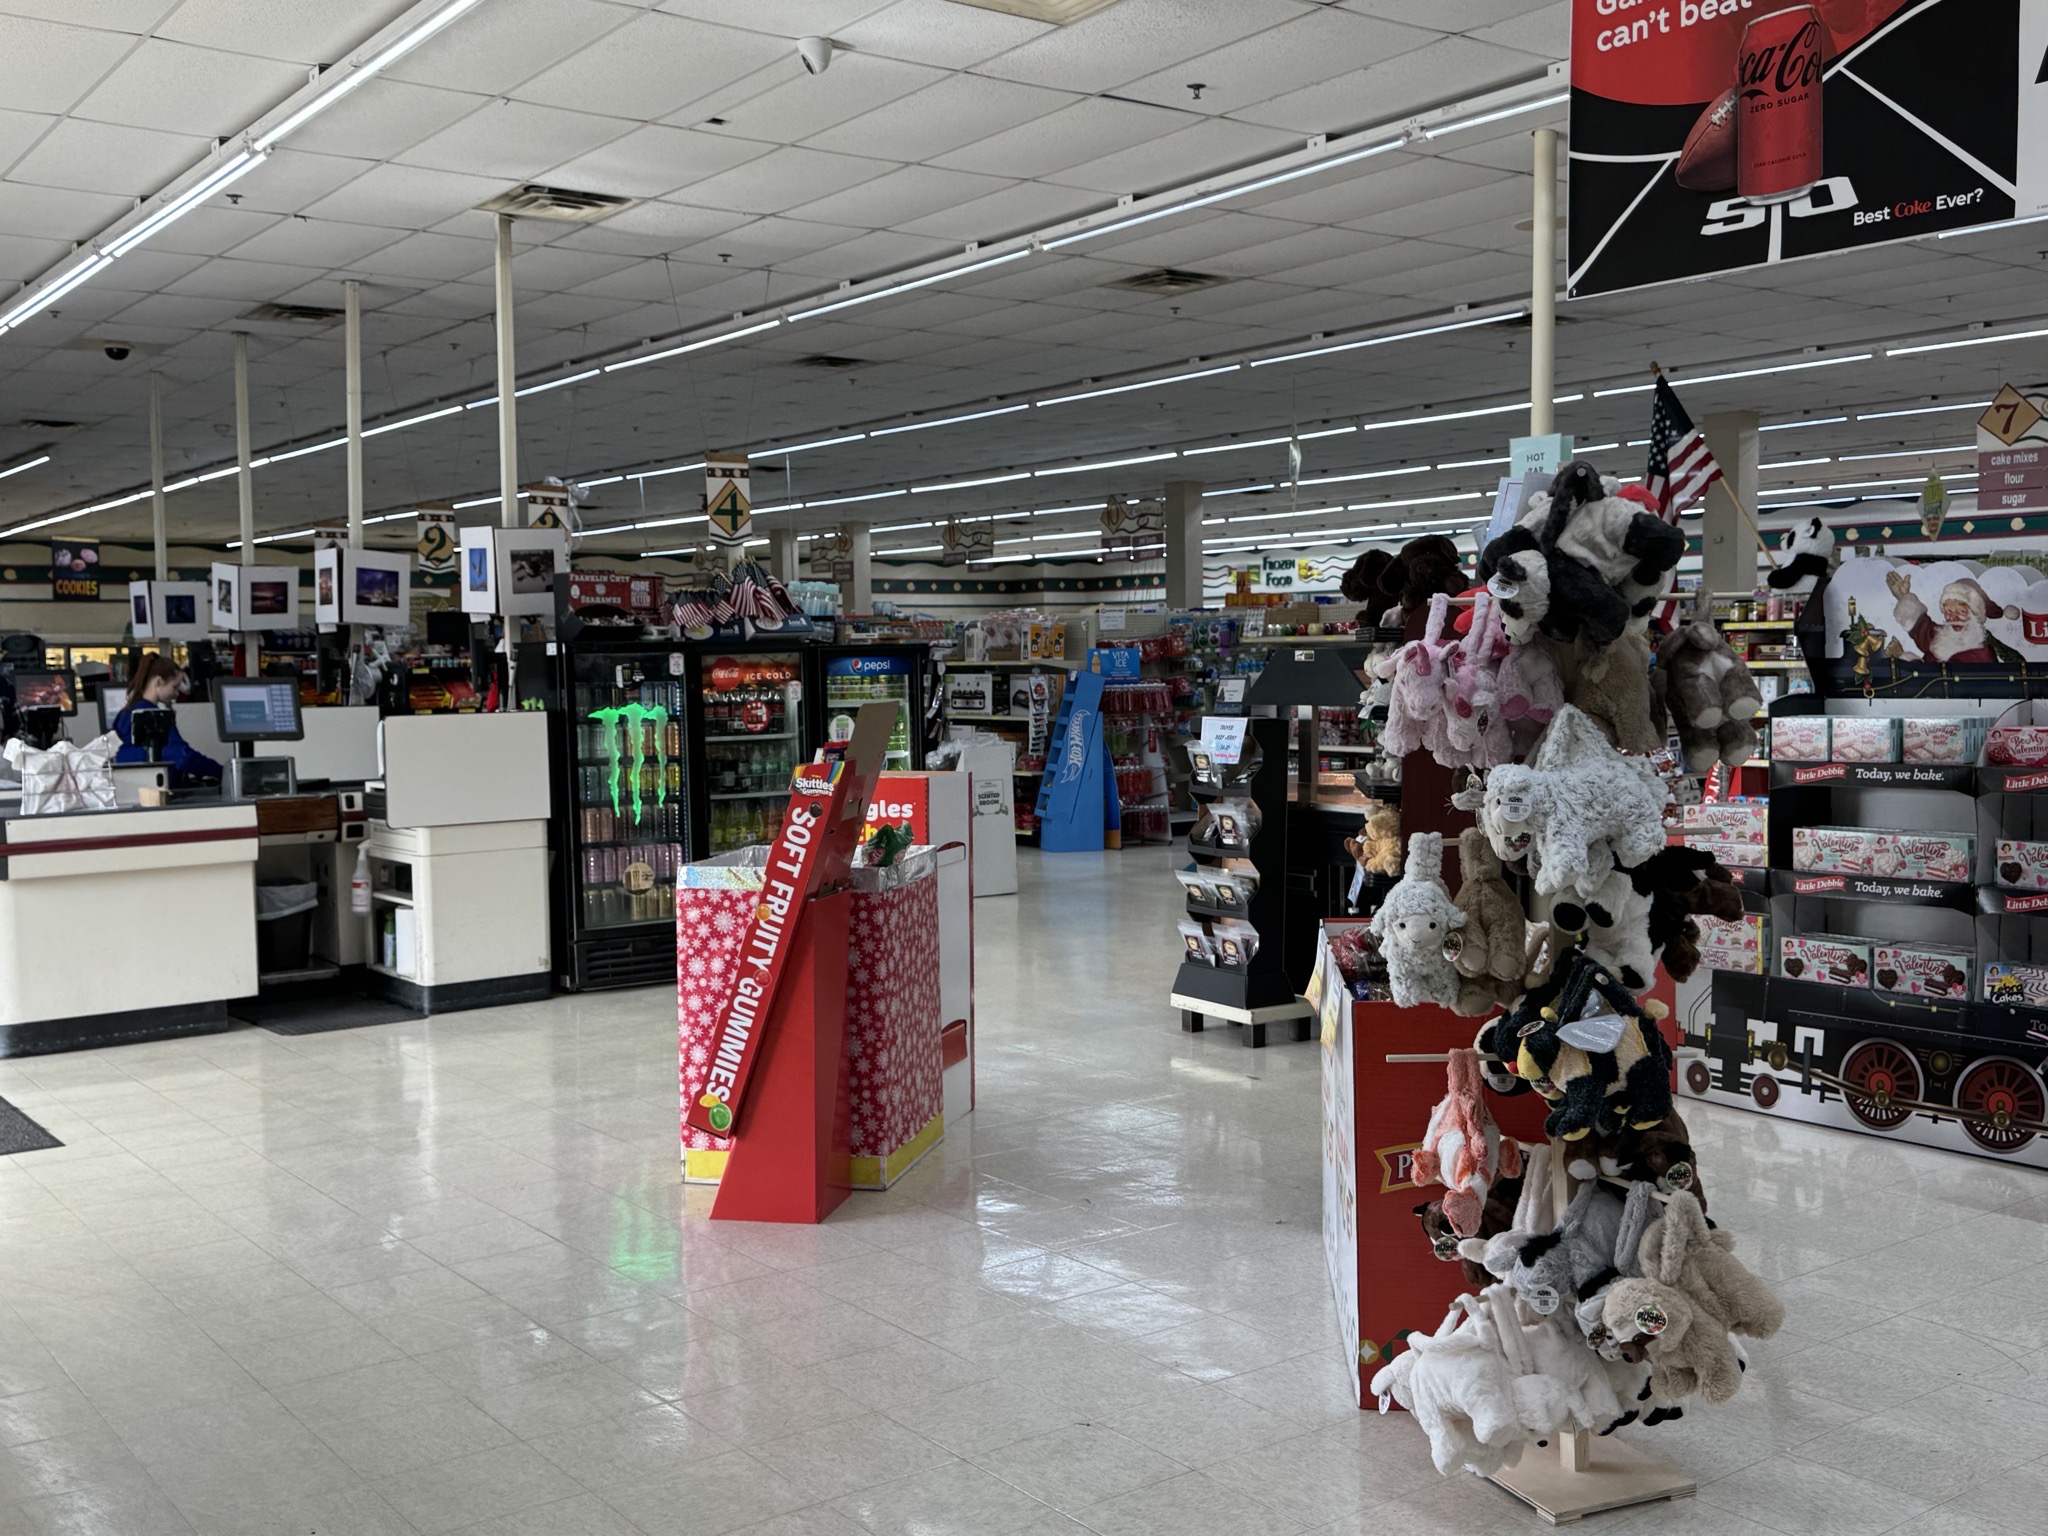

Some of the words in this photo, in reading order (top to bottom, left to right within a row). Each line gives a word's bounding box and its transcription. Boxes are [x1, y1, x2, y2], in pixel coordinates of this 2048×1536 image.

[1596, 7, 1670, 51] can't
[1750, 102, 1773, 113] ZERO
[1777, 93, 1810, 107] SUGAR
[1853, 206, 1891, 226] Best
[1894, 199, 1933, 218] Coke
[1935, 187, 1984, 211] Ever?
[1994, 401, 2020, 435] 7
[1526, 452, 1546, 462] HOT
[1991, 452, 2012, 466] cake
[2013, 451, 2039, 464] mixes
[2004, 472, 2025, 485] flour
[2001, 494, 2027, 507] sugar
[713, 486, 744, 531] 4
[424, 525, 453, 563] 2
[1266, 572, 1293, 586] FOOD
[55, 579, 98, 596] COOKIES
[1111, 651, 1130, 659] VITA
[863, 659, 891, 672] pepsi
[1115, 659, 1127, 667] ICE
[746, 672, 762, 680] ICE
[766, 671, 791, 680] COLD
[2011, 734, 2025, 745] Be
[1795, 770, 1816, 781] Little
[1817, 766, 1845, 778] Debbie
[1855, 767, 1892, 782] Today,
[1895, 771, 1911, 780] we
[1912, 768, 1945, 781] bake.
[795, 777, 835, 791] Skittles
[2005, 778, 2029, 789] Little
[801, 788, 833, 797] Gummies
[776, 806, 816, 880] SOFT
[1811, 831, 1862, 852] Valentine
[1894, 837, 1949, 860] Valentine
[1795, 880, 1816, 890] Little
[1817, 878, 1844, 888] Debbie
[1855, 881, 1891, 896] Today,
[1894, 886, 1910, 895] we
[1912, 885, 1943, 898] bake.
[2006, 898, 2030, 910] Little
[747, 878, 796, 972] FRUITY
[1988, 983, 2024, 996] Zebra
[1991, 991, 2024, 1004] Cakes
[705, 977, 764, 1103] GUMMIES
